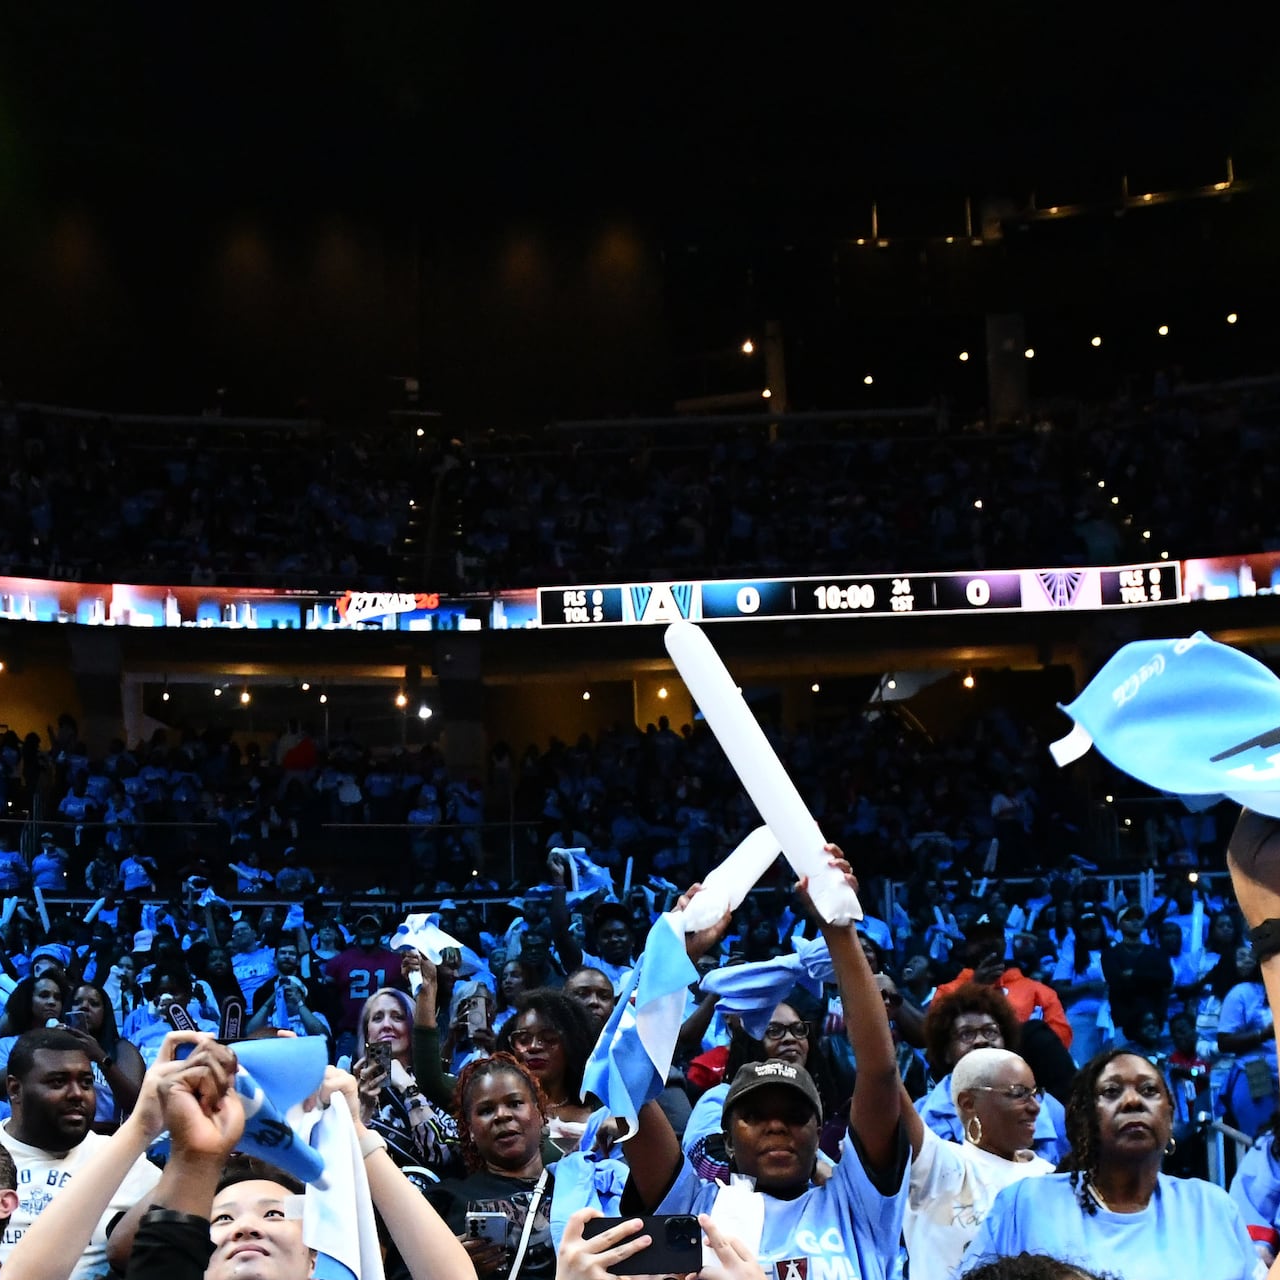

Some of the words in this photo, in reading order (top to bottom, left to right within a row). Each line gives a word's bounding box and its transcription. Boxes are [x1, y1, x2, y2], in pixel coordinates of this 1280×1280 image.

[891, 579, 911, 595] 24
[1119, 570, 1144, 588] FLS
[1149, 567, 1161, 584] 0
[563, 590, 587, 607] FLS
[592, 589, 603, 606] 0
[736, 586, 761, 613] 0
[813, 583, 875, 611] 10:00
[965, 579, 991, 606] 0
[1120, 586, 1148, 603] TOL
[1150, 585, 1161, 600] 5
[890, 595, 915, 612] 1ST
[563, 607, 590, 623] TOL
[592, 606, 603, 622] 5
[348, 968, 386, 999] 21
[795, 1229, 846, 1254] GO
